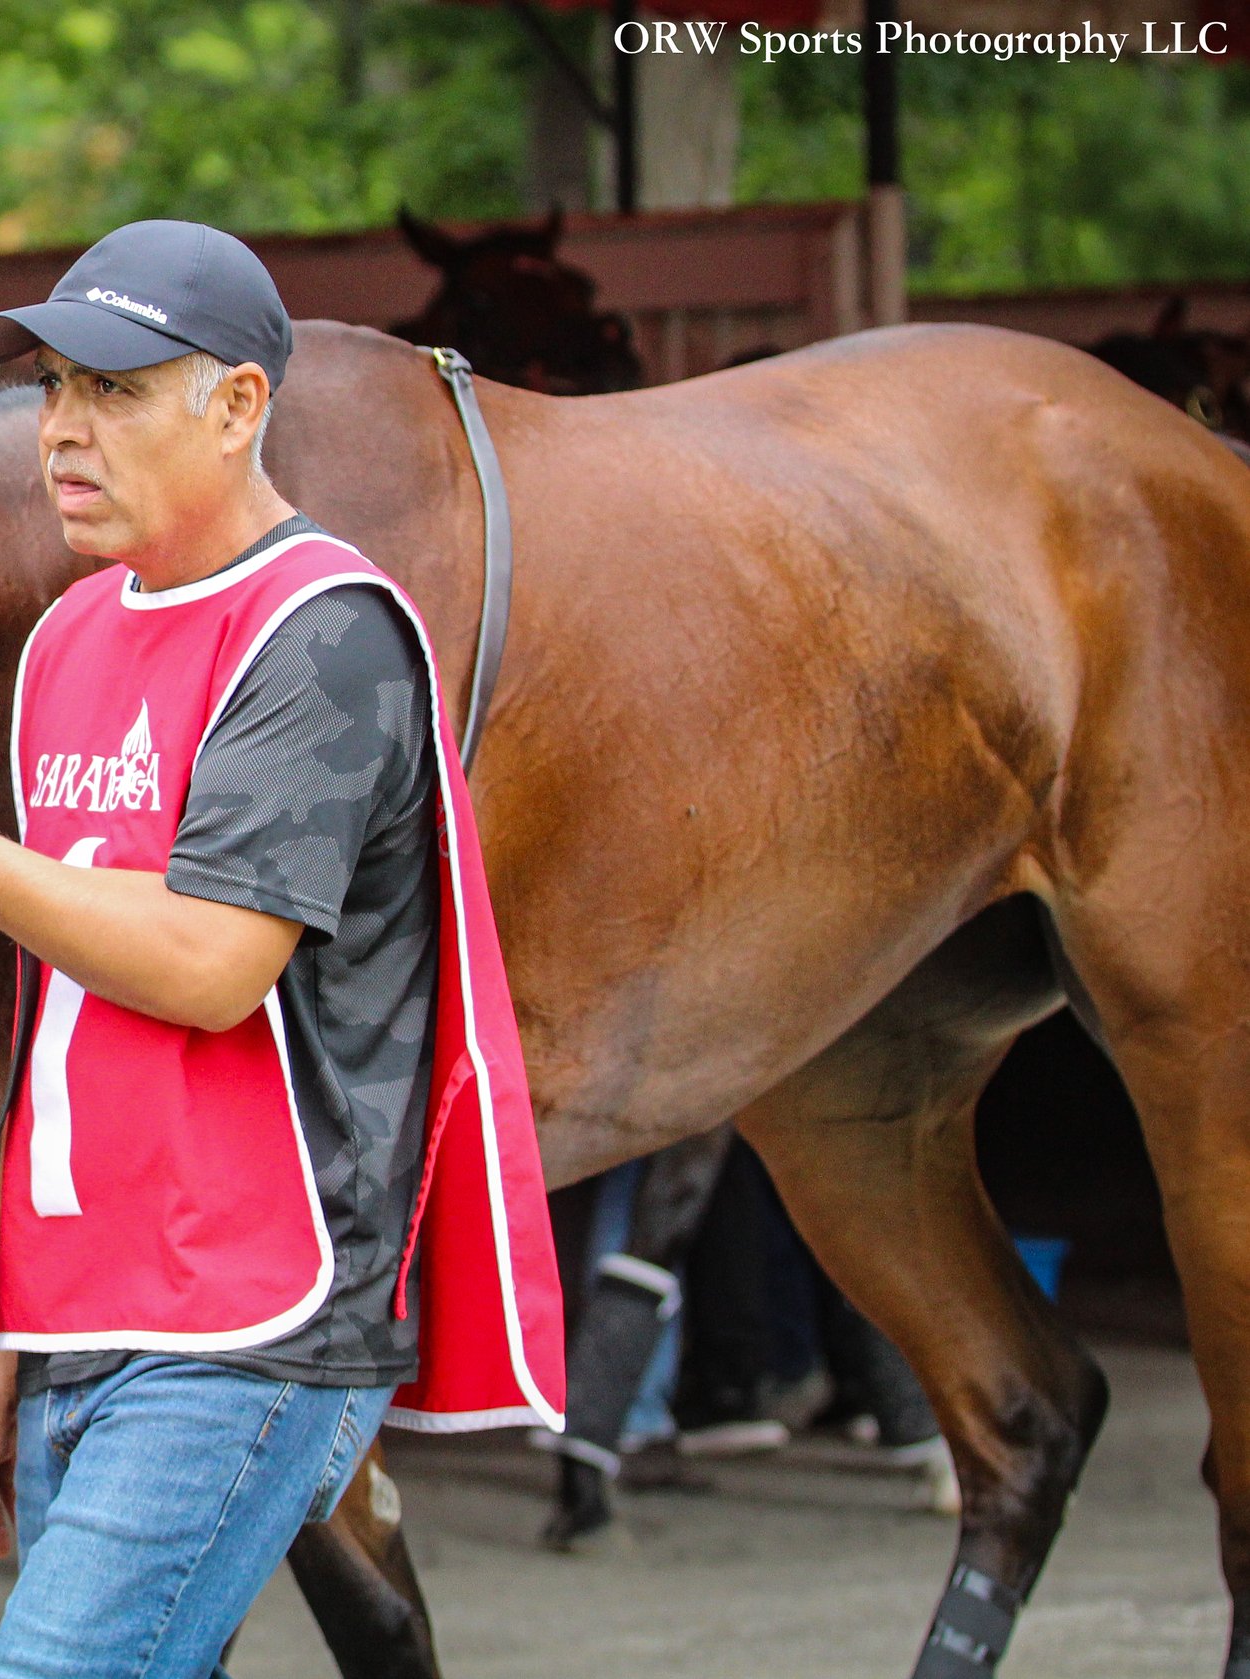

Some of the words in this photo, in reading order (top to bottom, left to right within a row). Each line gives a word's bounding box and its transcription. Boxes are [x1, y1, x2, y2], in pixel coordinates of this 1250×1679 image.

[100, 290, 168, 325] Columbia
[29, 752, 162, 812] SARATOGA
[30, 836, 108, 1218] 1
